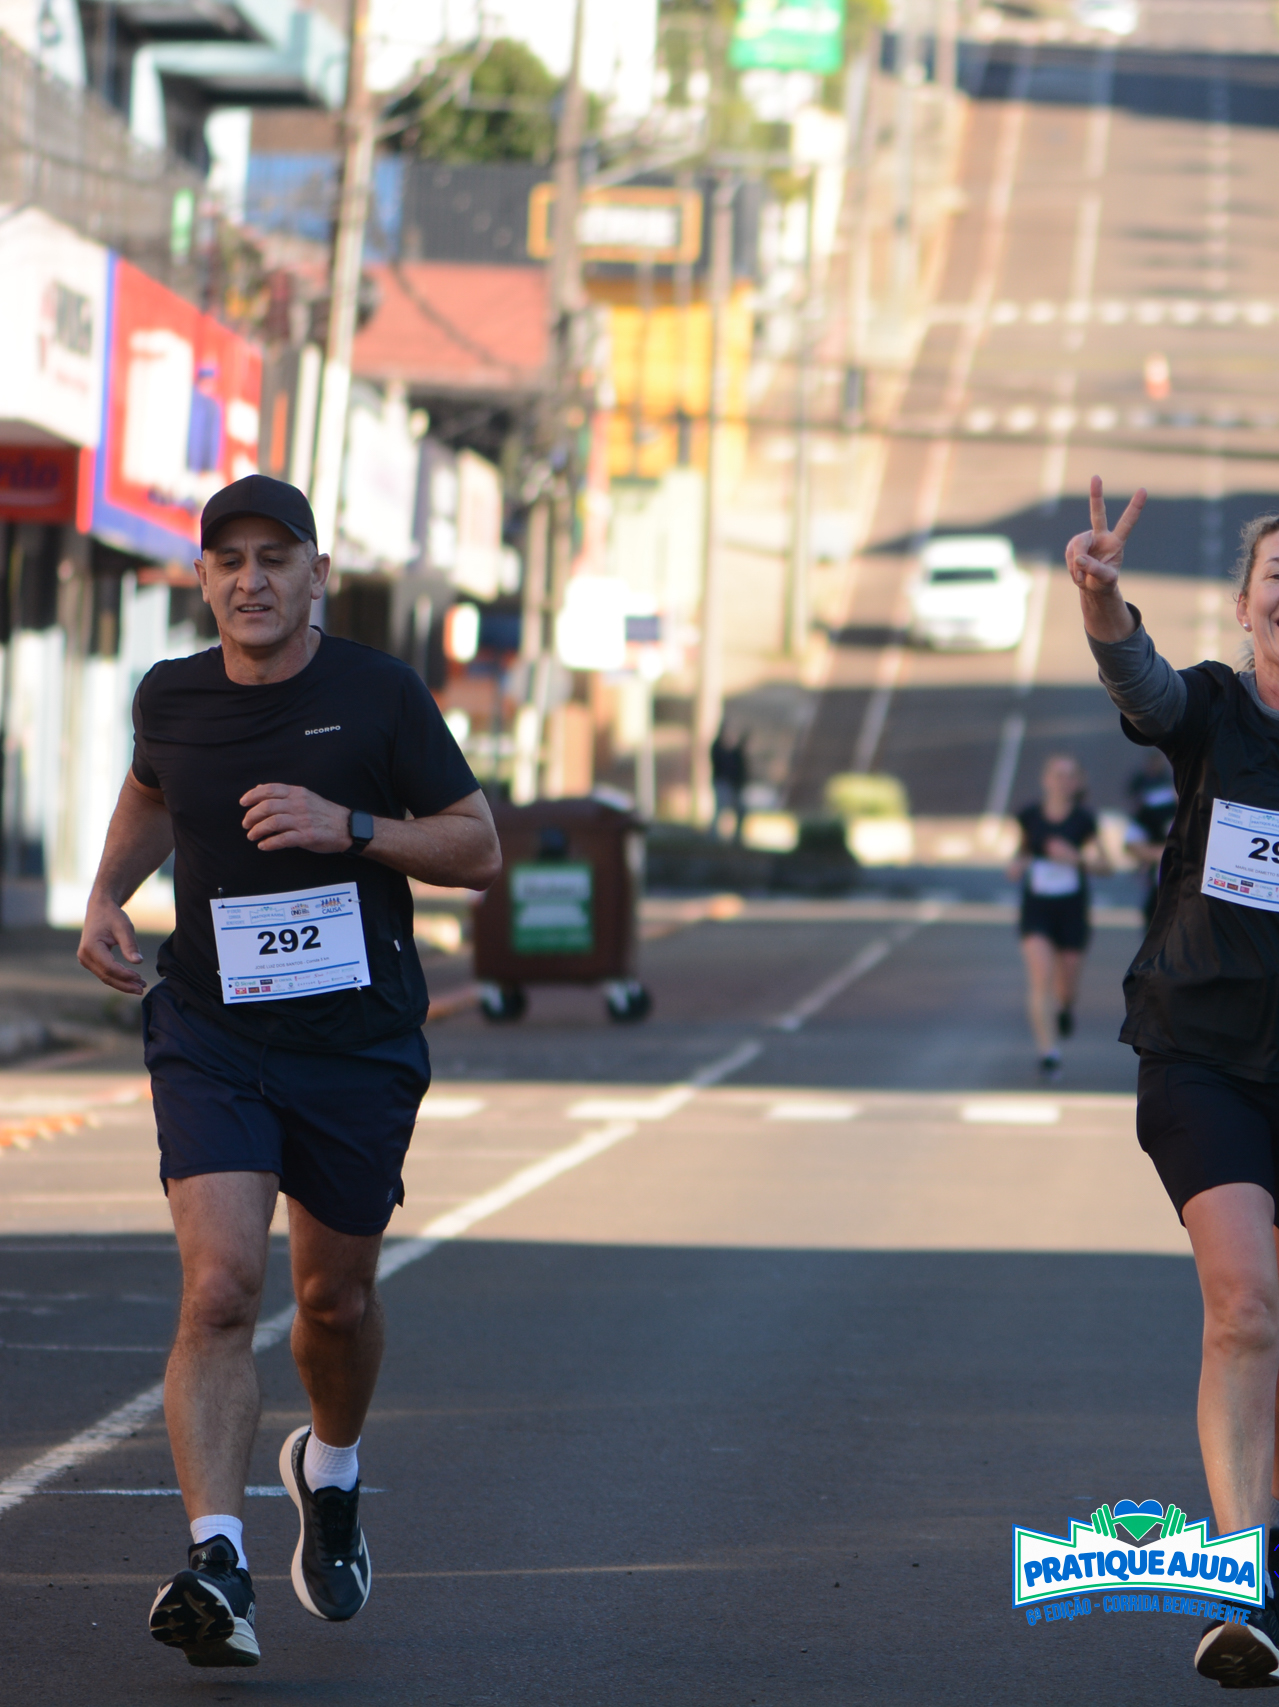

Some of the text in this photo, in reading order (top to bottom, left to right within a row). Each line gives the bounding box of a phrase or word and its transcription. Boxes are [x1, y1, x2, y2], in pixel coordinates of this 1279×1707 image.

[304, 725, 341, 736] DICORPO
[321, 906, 342, 915] CAUSA
[257, 925, 322, 956] 292
